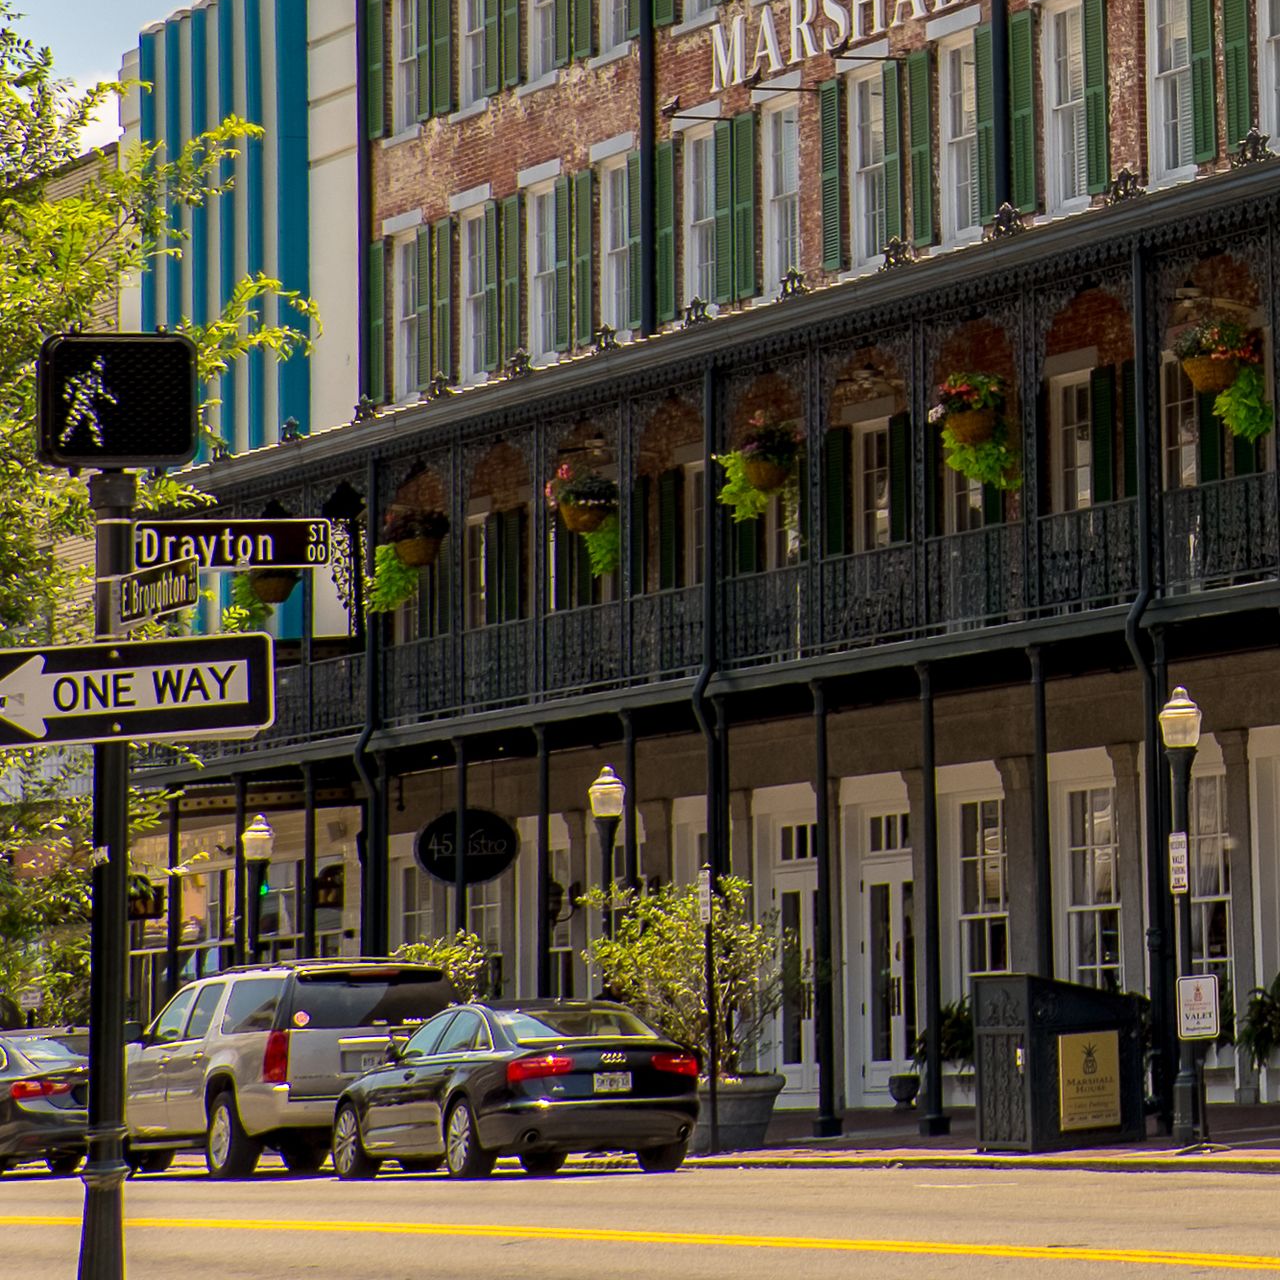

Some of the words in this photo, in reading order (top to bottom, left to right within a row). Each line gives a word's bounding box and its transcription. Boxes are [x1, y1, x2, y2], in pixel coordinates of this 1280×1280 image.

[142, 527, 274, 568] Drayton
[309, 524, 326, 540] ST
[307, 545, 327, 563] 00
[132, 570, 187, 615] Broughton
[52, 671, 137, 713] ONE
[153, 664, 238, 705] WAY
[428, 833, 453, 861] 45
[463, 829, 508, 856] istro
[1185, 1012, 1212, 1020] VALET
[1066, 1075, 1113, 1087] MARSHALL
